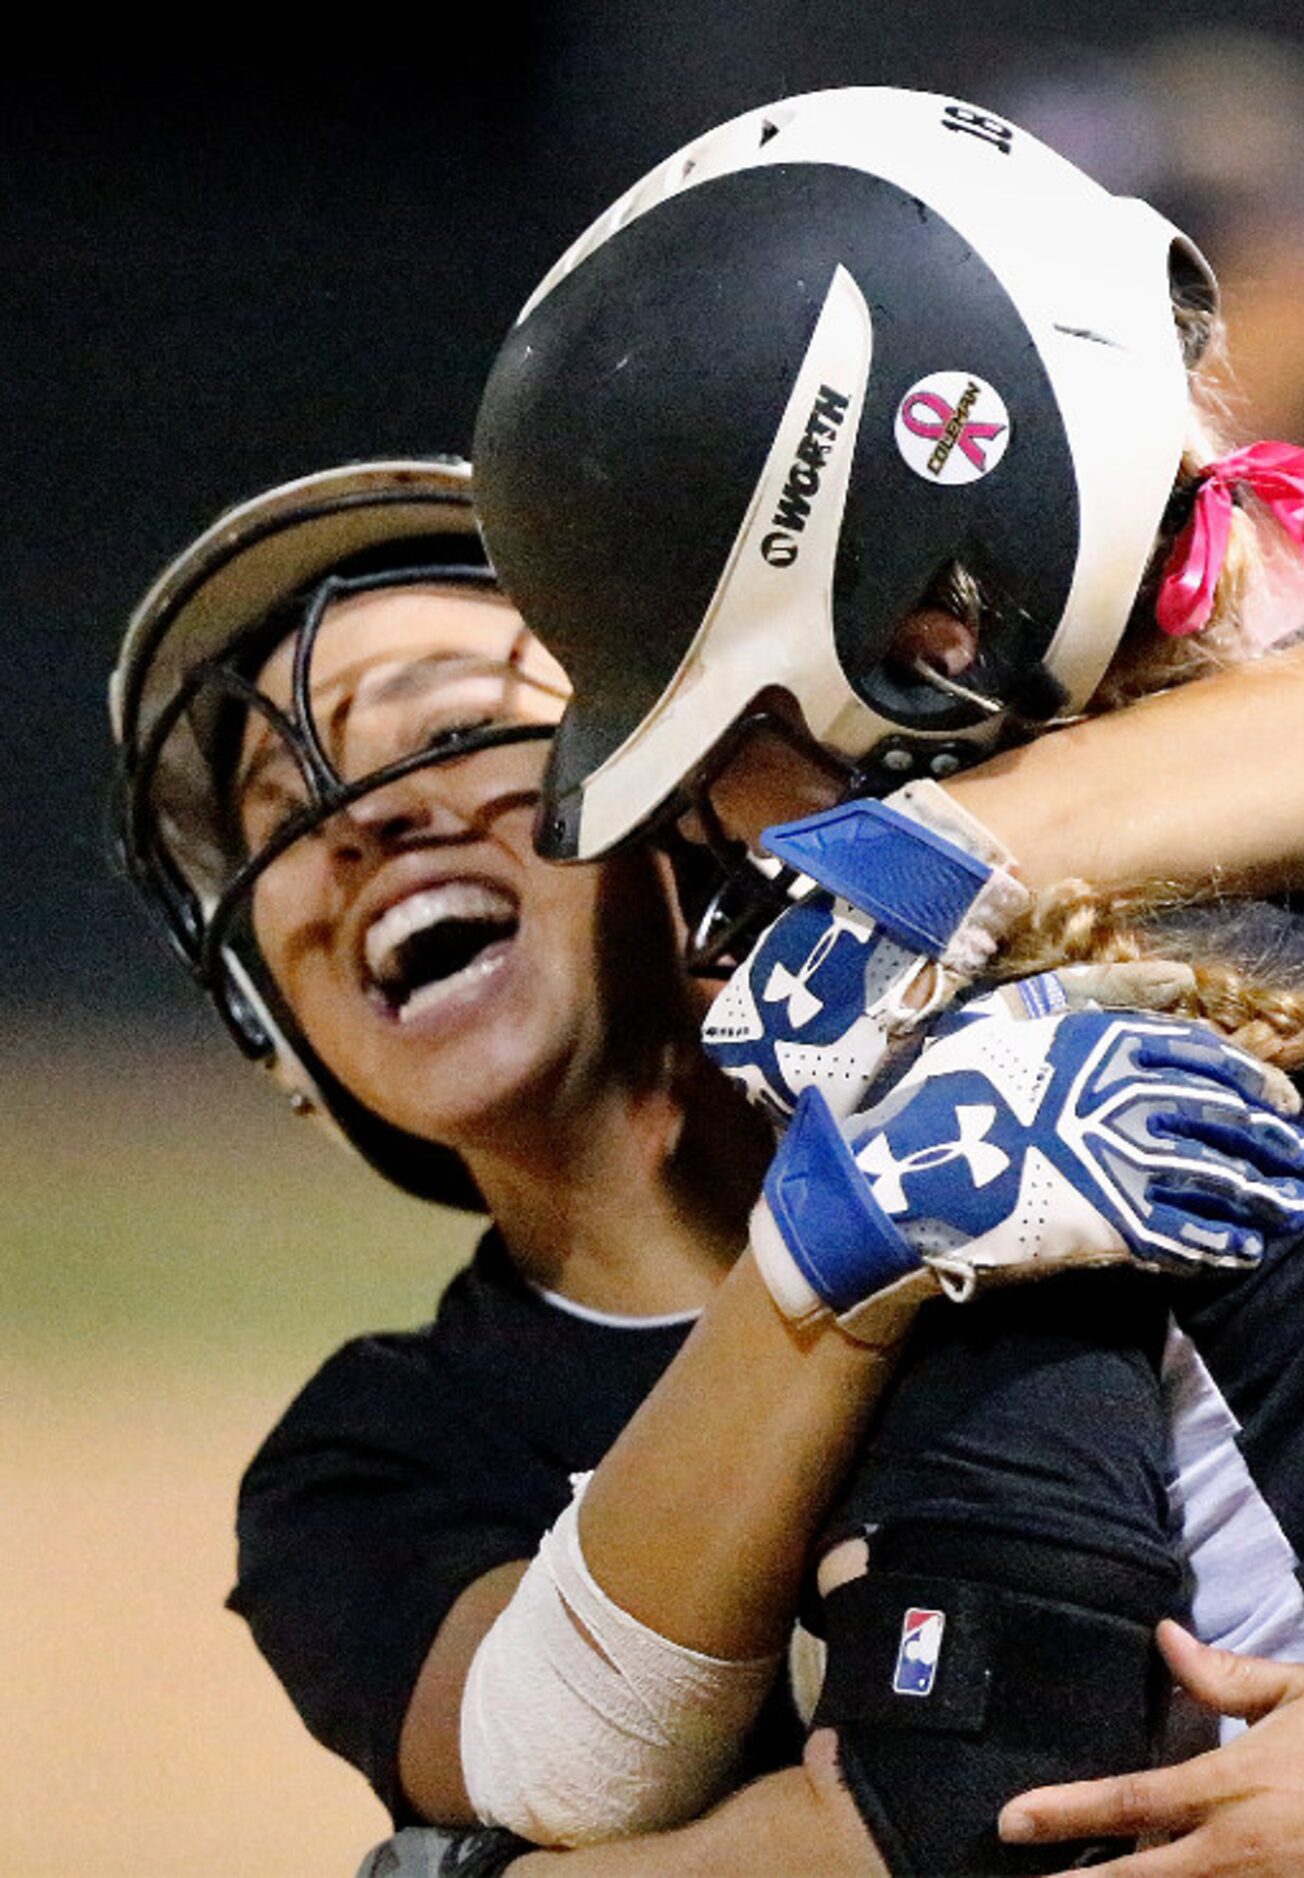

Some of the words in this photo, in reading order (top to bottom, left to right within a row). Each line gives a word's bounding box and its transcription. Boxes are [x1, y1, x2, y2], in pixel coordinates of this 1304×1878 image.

[941, 106, 1013, 155] 18
[772, 384, 850, 533] WORTH
[926, 380, 982, 477] COLEMAN
